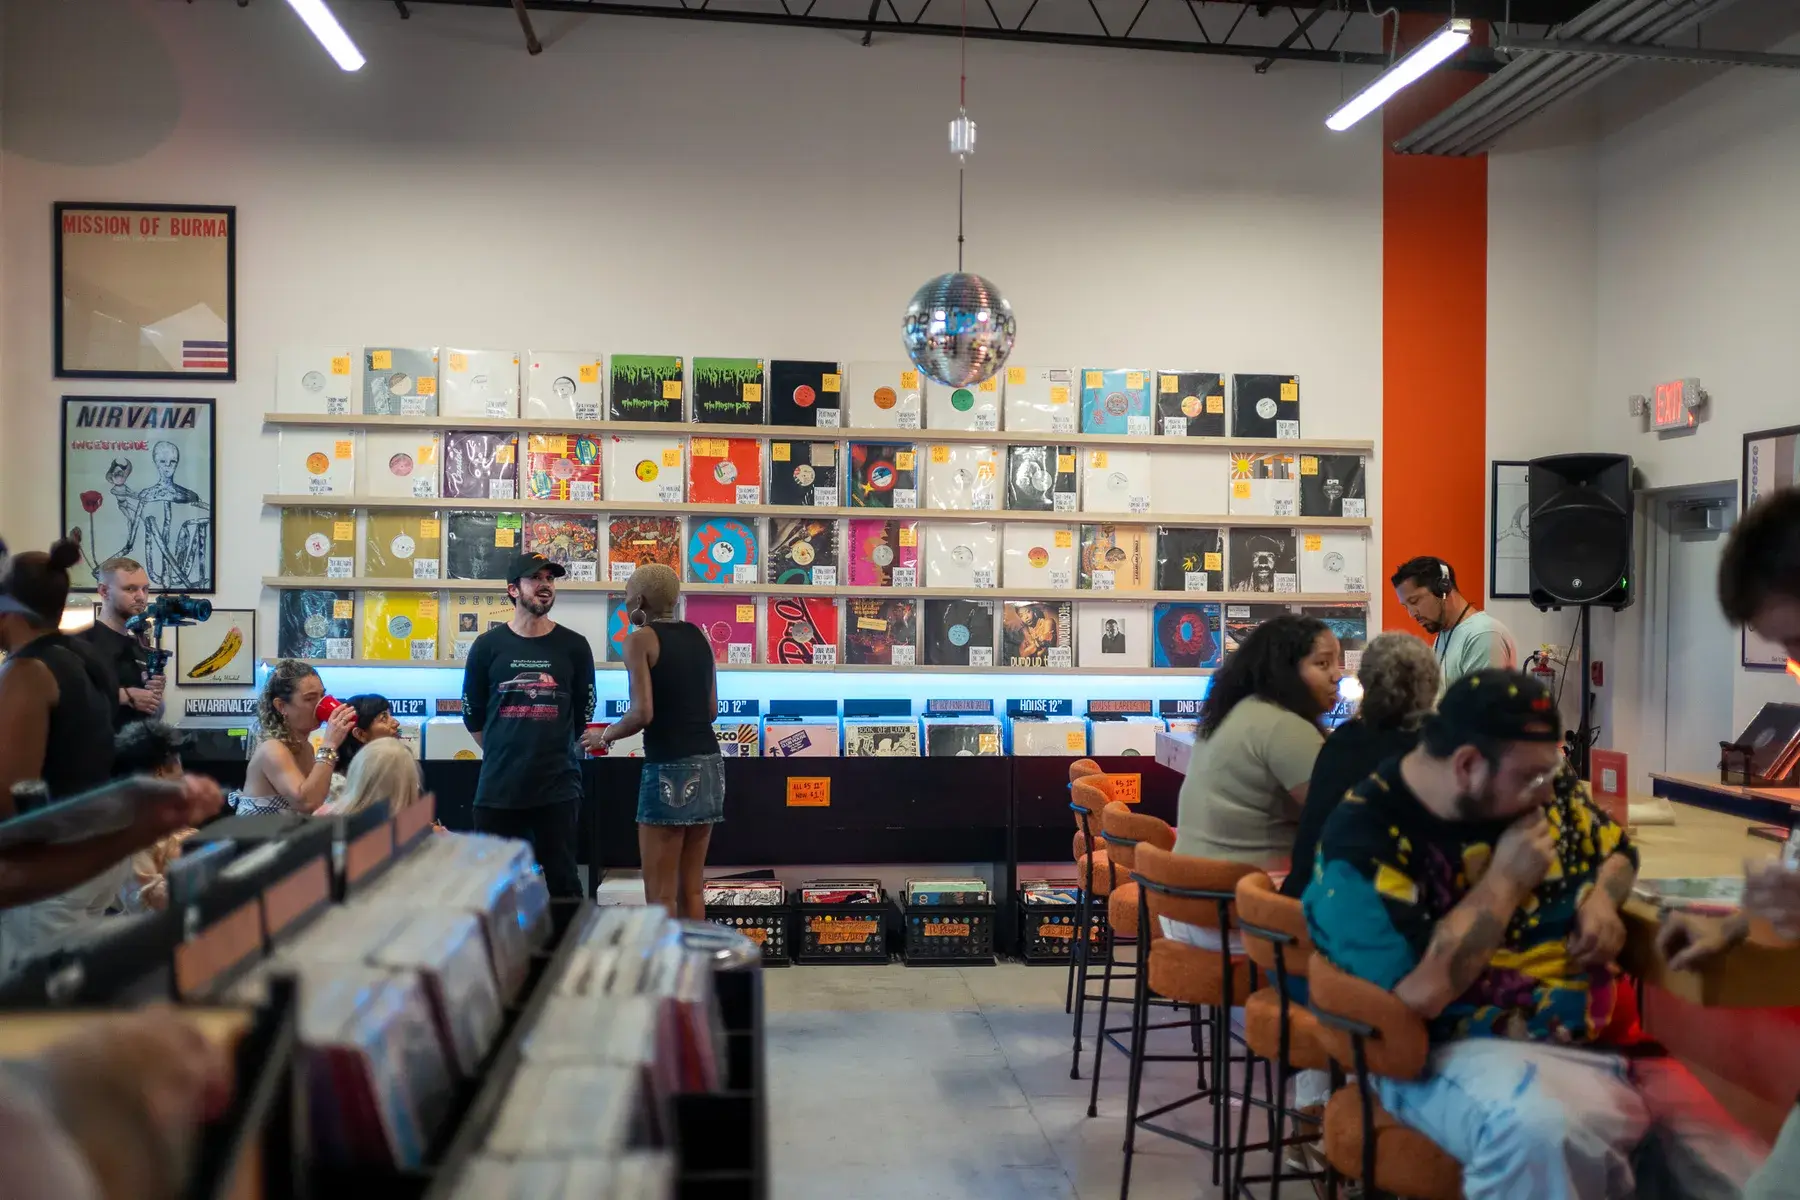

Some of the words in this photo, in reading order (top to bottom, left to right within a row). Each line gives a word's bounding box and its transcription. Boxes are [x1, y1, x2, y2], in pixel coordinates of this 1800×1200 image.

[63, 214, 130, 235] MISSION
[139, 216, 160, 235] OF
[170, 217, 227, 237] BURMA
[1655, 381, 1684, 425] EXIT
[76, 405, 197, 429] NIRVANA
[71, 440, 149, 451] INCESTICIDE
[186, 699, 207, 713] NEW
[207, 699, 243, 713] ARRIVAL
[1020, 699, 1047, 712] HOUSE
[1177, 700, 1194, 713] DNB
